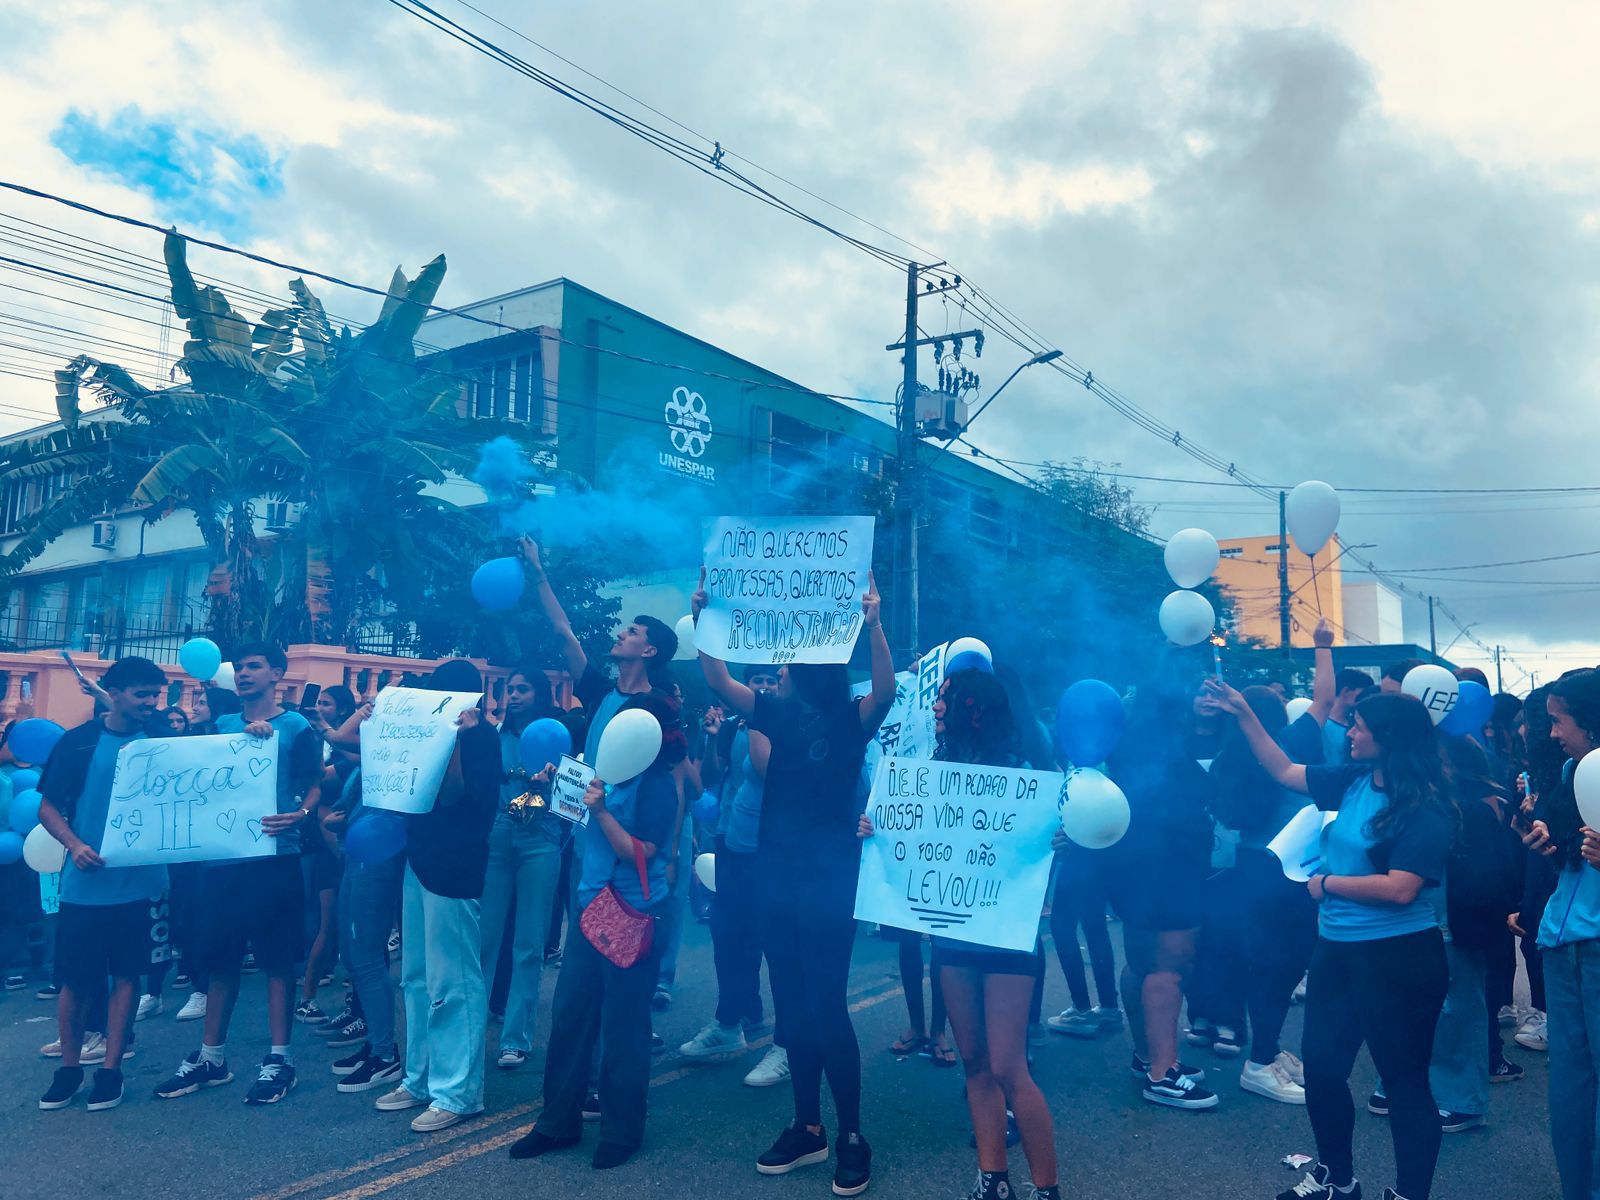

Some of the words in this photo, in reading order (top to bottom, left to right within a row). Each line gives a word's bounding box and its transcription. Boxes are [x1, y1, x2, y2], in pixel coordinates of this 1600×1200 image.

[659, 452, 715, 481] UNESPAR
[722, 526, 757, 559] NÃO
[762, 530, 848, 559] QUEREMOS
[709, 568, 788, 601] PROMESSAS,
[789, 569, 857, 601] QUEREMOS
[727, 602, 860, 650] RECONSTRUÇÃO
[880, 722, 902, 758] RE
[114, 744, 245, 806] Força
[939, 769, 961, 797] UM
[1016, 776, 1038, 800] DA
[875, 803, 924, 831] NOSSA
[933, 802, 965, 829] VIDA
[972, 808, 1017, 833] QUE
[894, 840, 906, 862] O
[918, 842, 953, 862] FOGO
[966, 843, 997, 867] NÃO
